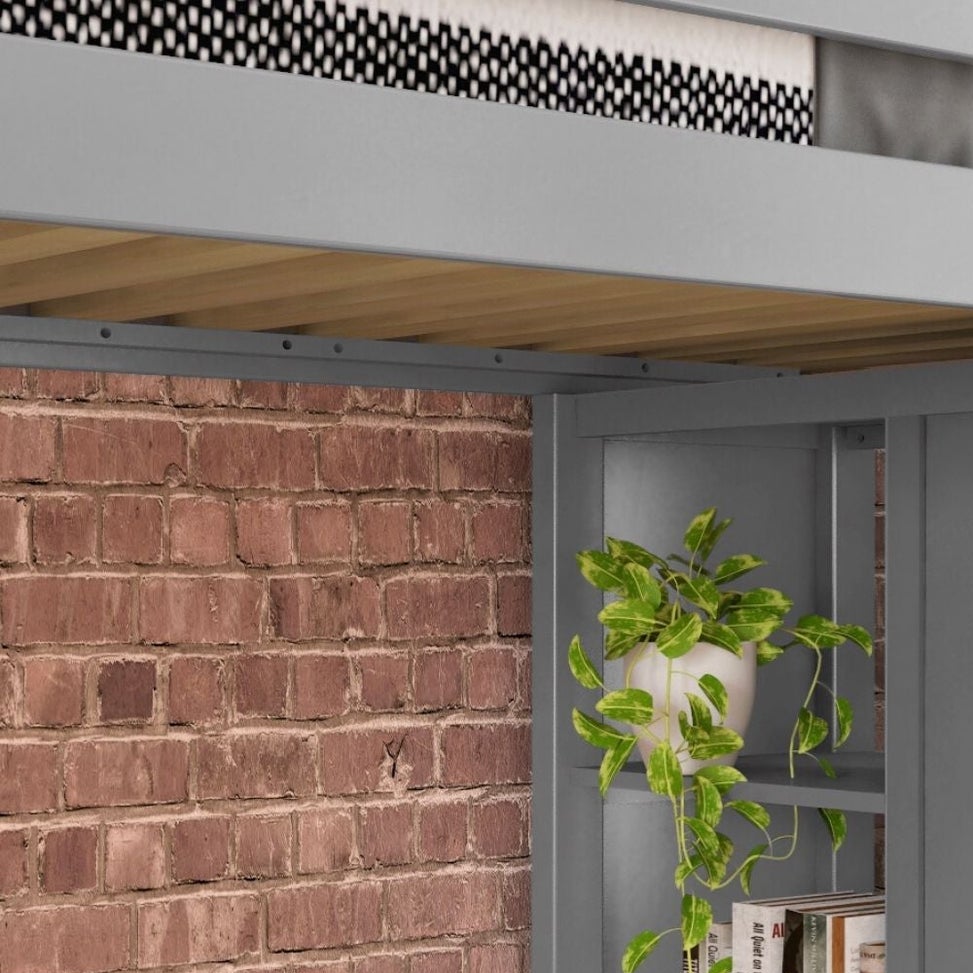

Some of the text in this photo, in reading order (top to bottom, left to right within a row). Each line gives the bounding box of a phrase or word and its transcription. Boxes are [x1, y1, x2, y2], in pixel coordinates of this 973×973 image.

[752, 921, 764, 934] All
[750, 936, 765, 957] Quiet
[752, 959, 762, 969] on
